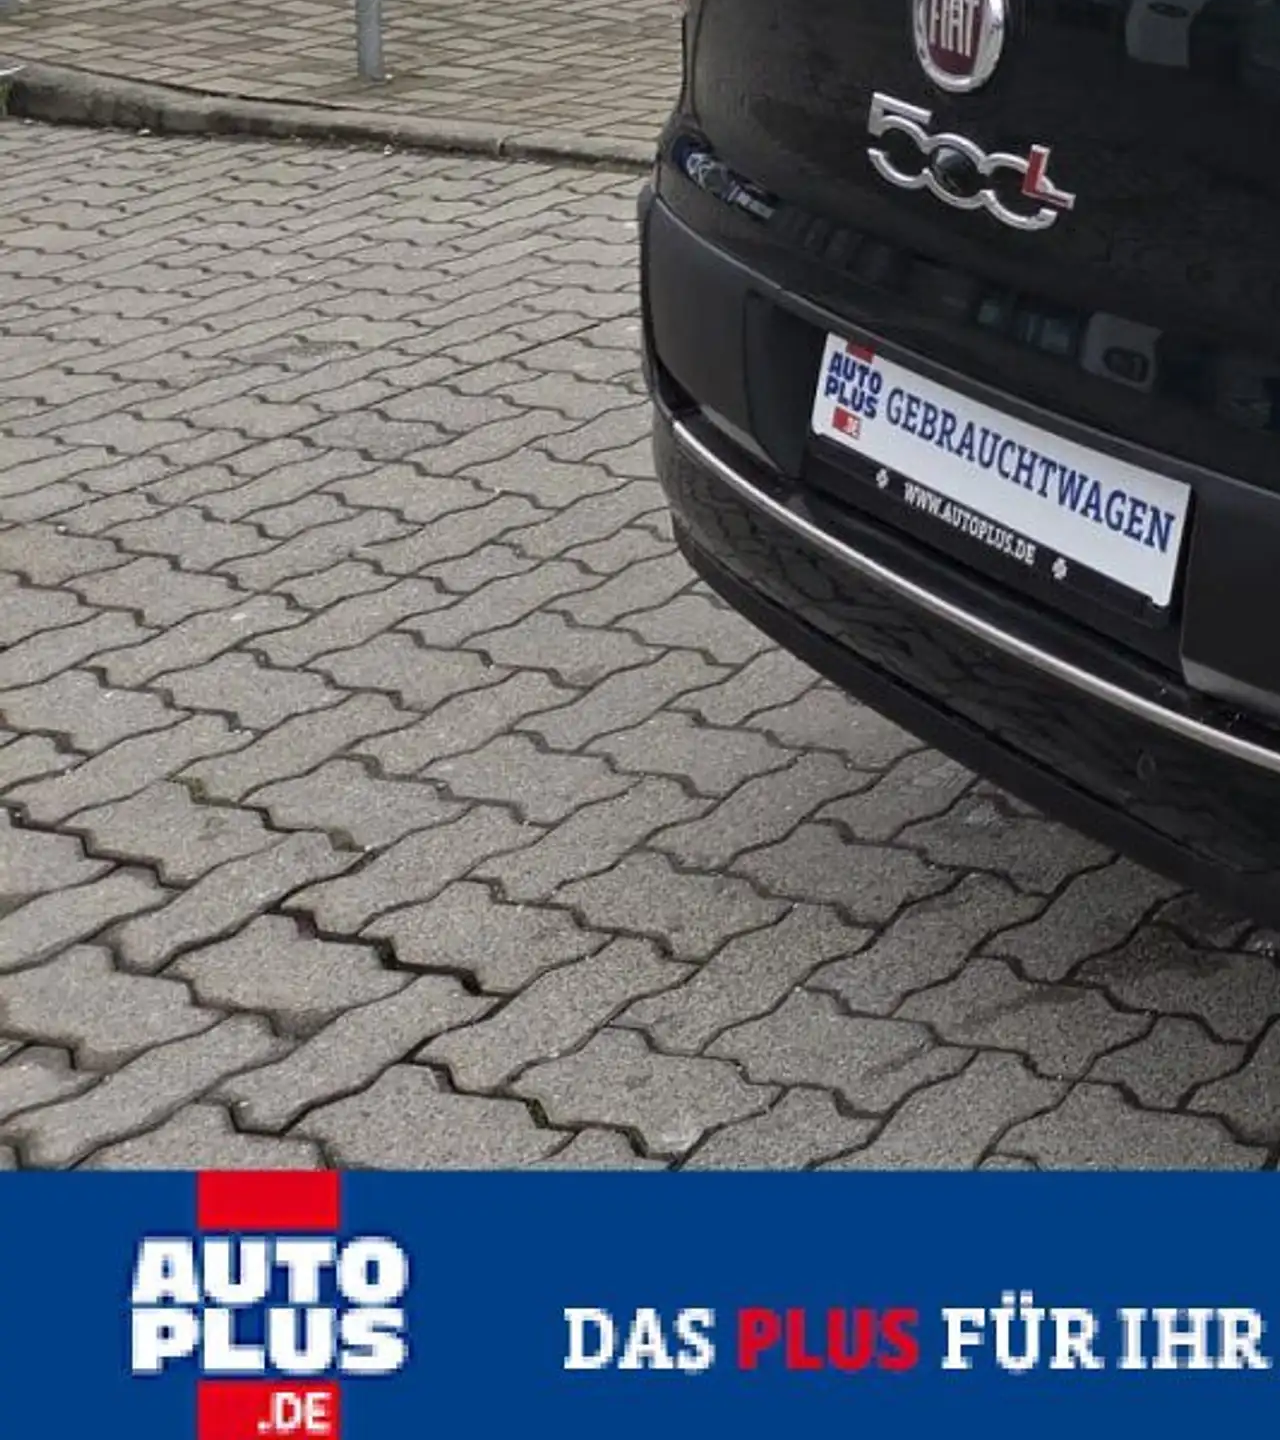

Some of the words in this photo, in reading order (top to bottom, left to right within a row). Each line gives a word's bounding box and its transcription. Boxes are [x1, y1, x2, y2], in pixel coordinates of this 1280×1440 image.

[867, 92, 1076, 229] 500L
[824, 375, 877, 419] PLUS
[828, 351, 882, 395] AUTO
[886, 388, 1175, 553] GEBRAUCHTWAGEN
[904, 482, 1036, 565] WWW.AUTOPLUS.DE
